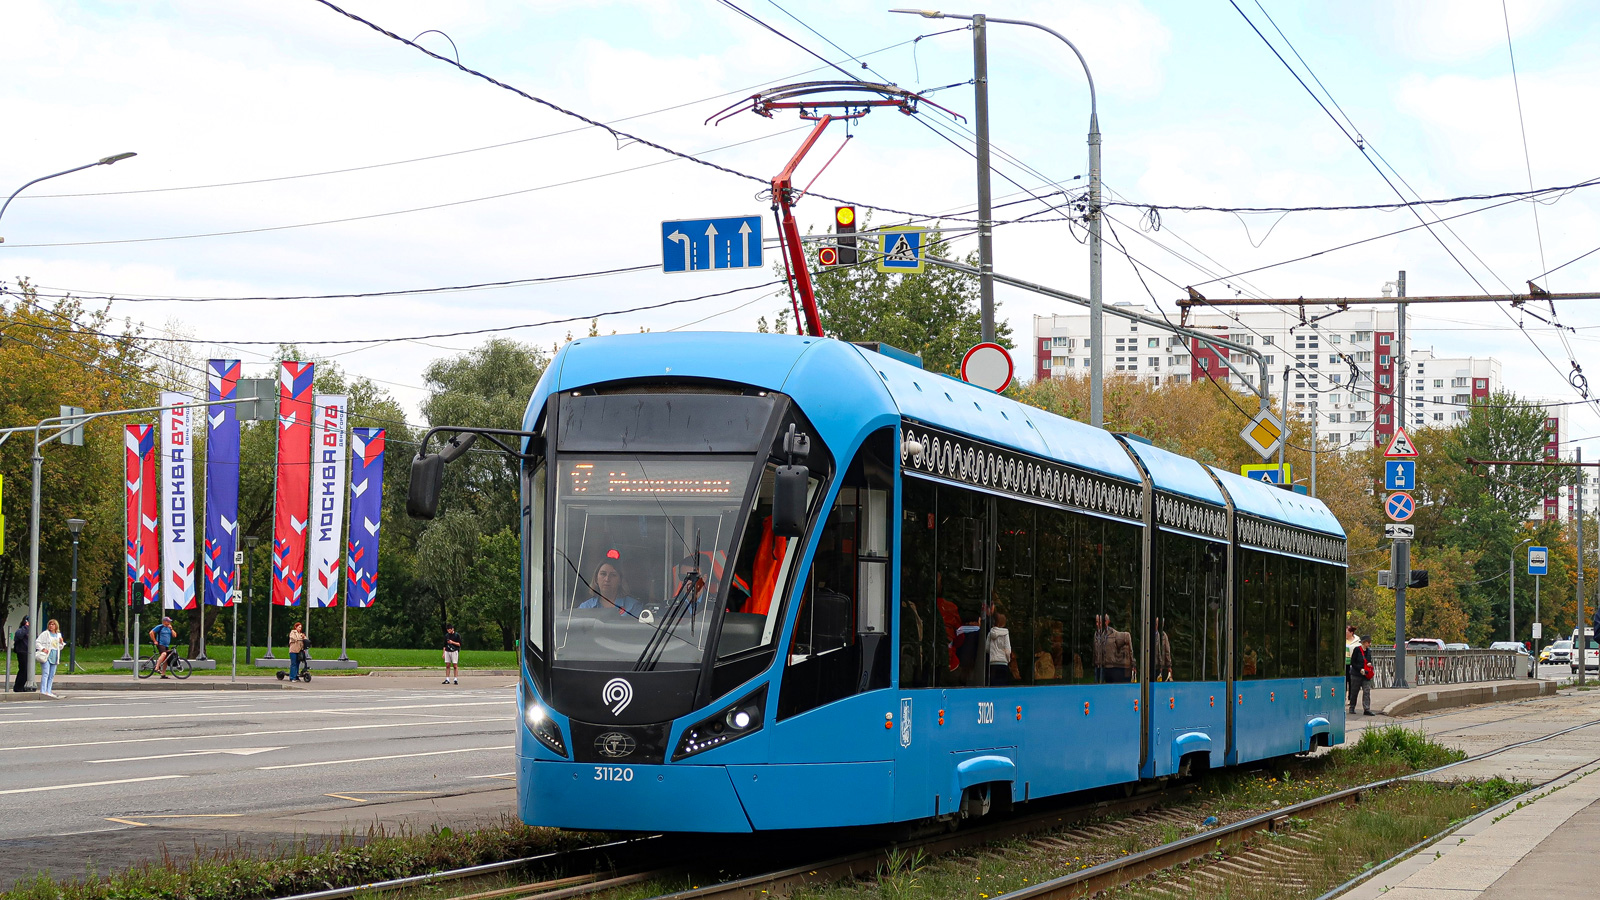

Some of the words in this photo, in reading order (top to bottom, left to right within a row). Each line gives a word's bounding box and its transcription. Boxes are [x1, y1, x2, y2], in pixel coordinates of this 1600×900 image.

[172, 402, 184, 445] 878
[323, 405, 337, 447] 878
[172, 449, 185, 543] МОСКВА
[319, 450, 336, 541] МОСКВА
[977, 702, 994, 724] 31120
[593, 766, 634, 782] 31120
